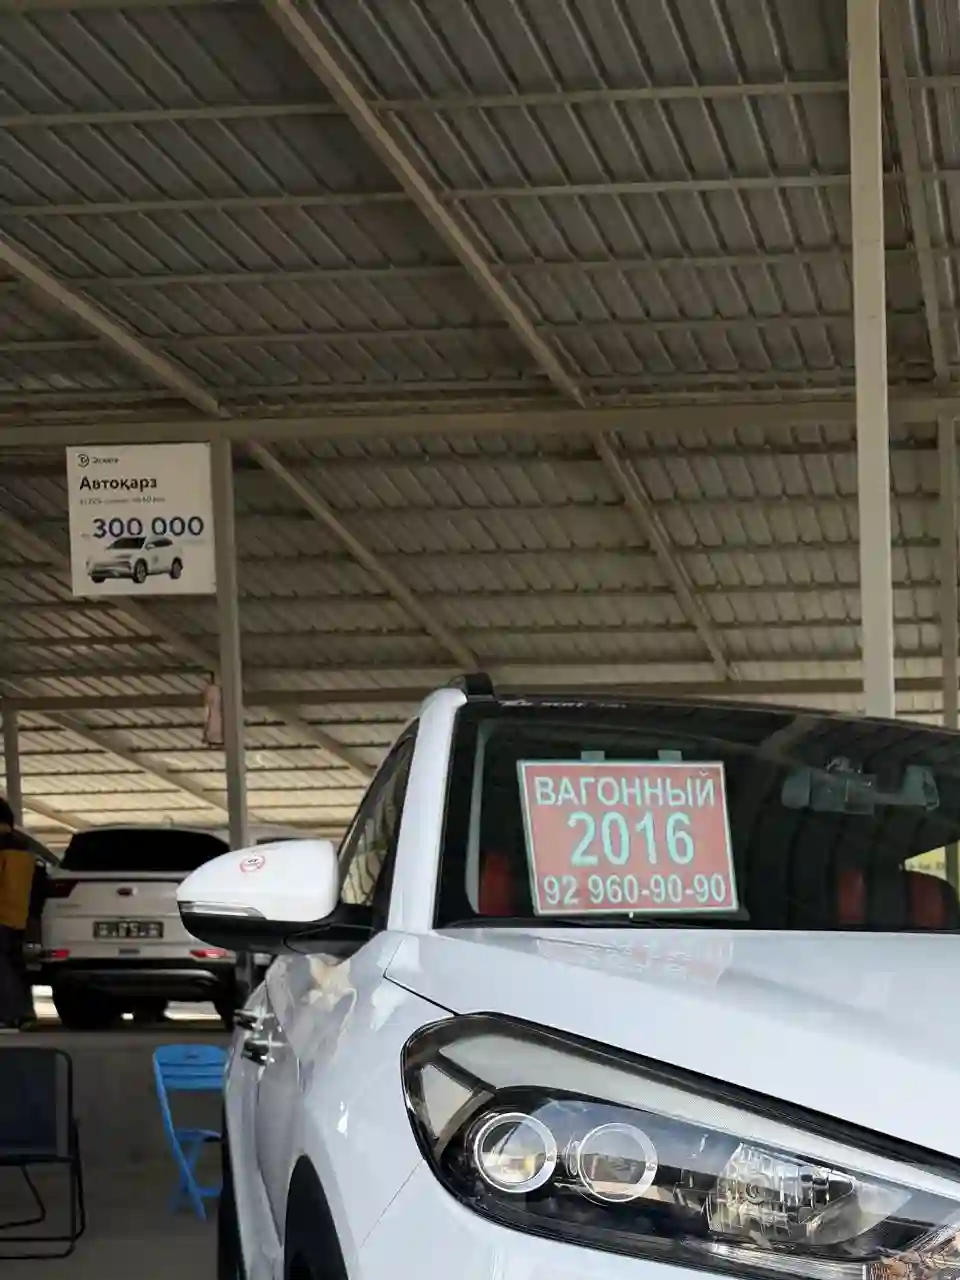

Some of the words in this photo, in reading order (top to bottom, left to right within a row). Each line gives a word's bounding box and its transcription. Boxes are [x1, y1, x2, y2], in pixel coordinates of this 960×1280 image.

[92, 517, 143, 539] 300
[151, 516, 204, 536] 000
[534, 770, 715, 807] ВАГОННЫЙ
[567, 811, 694, 867] 2016
[544, 875, 579, 905] 92
[588, 873, 726, 904] 960-90-90
